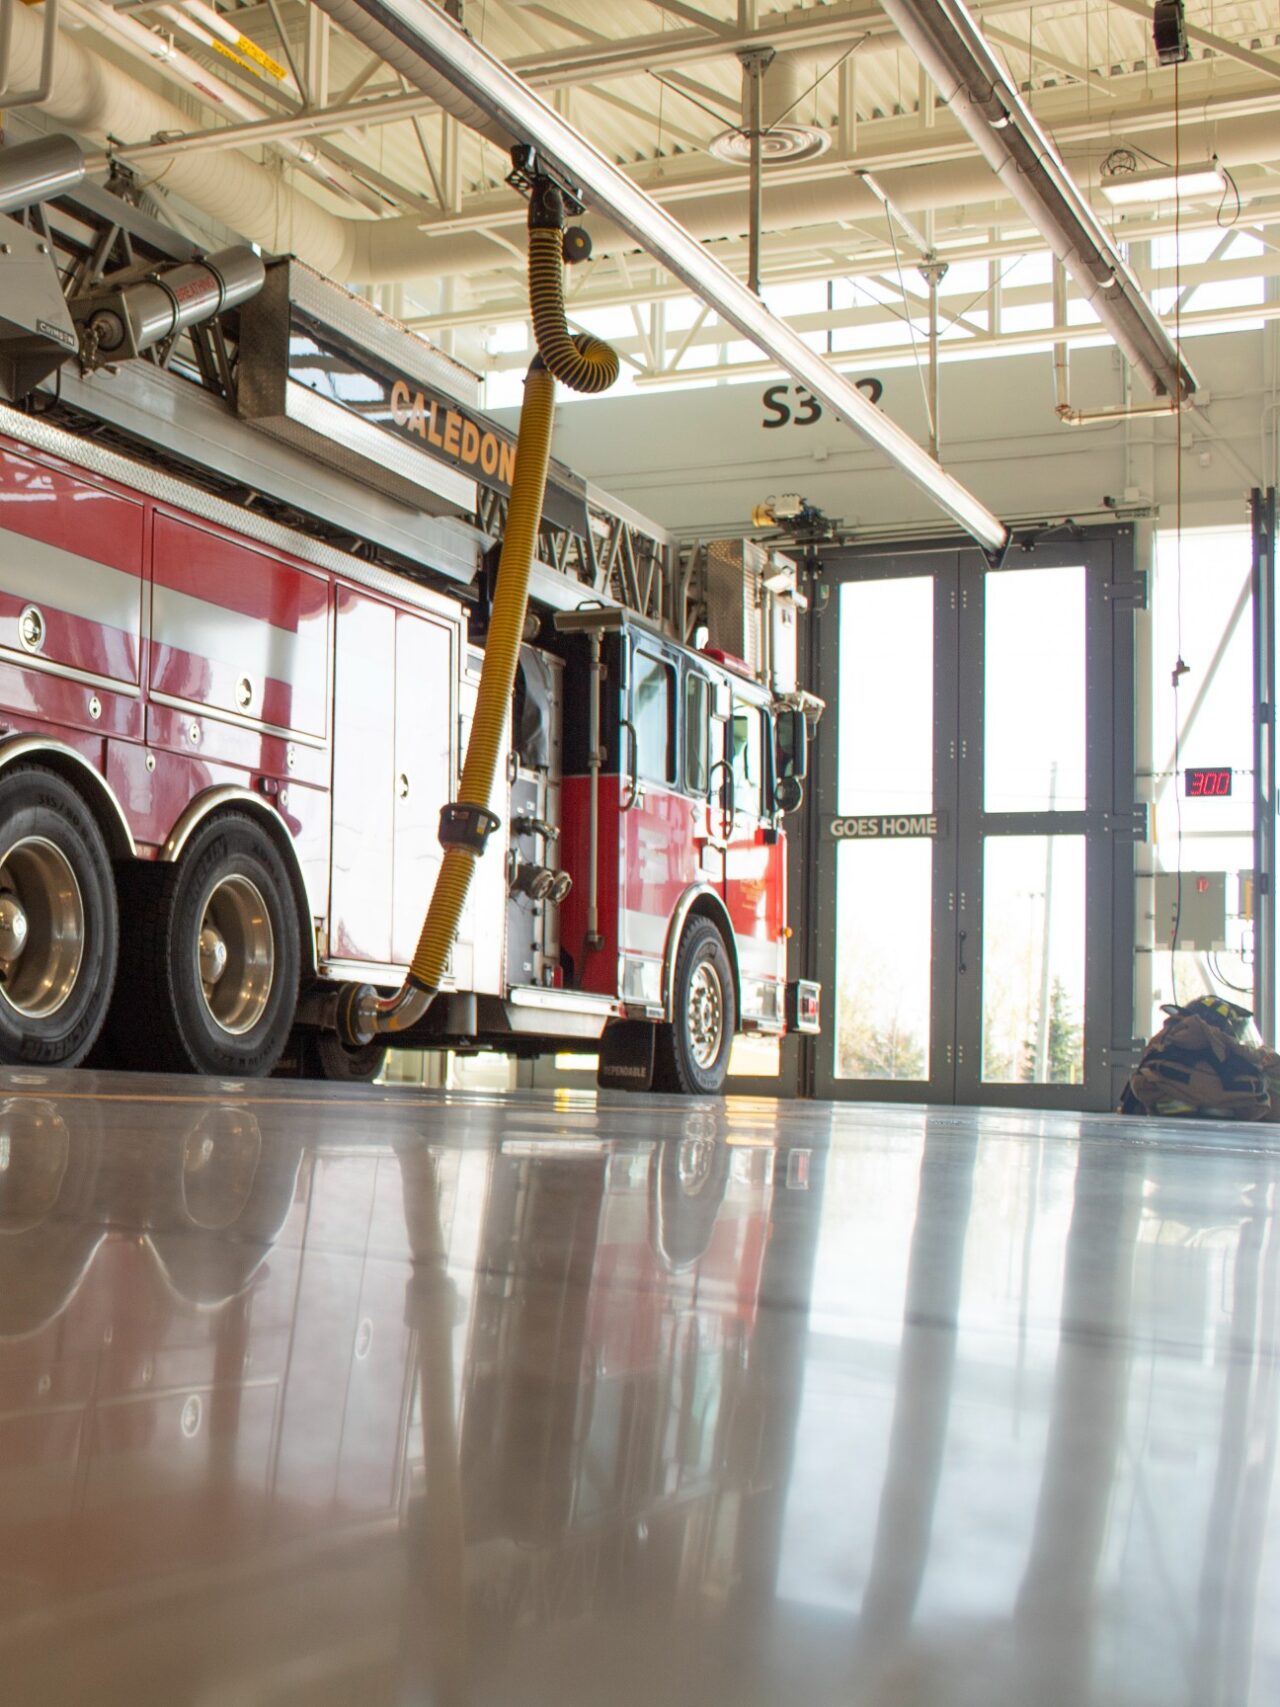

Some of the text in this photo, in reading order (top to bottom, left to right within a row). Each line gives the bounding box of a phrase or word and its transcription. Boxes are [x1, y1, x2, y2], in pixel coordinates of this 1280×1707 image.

[762, 377, 883, 429] S32
[390, 379, 517, 487] CALEDON
[1191, 771, 1230, 796] 300
[830, 817, 937, 836] GOES HOME
